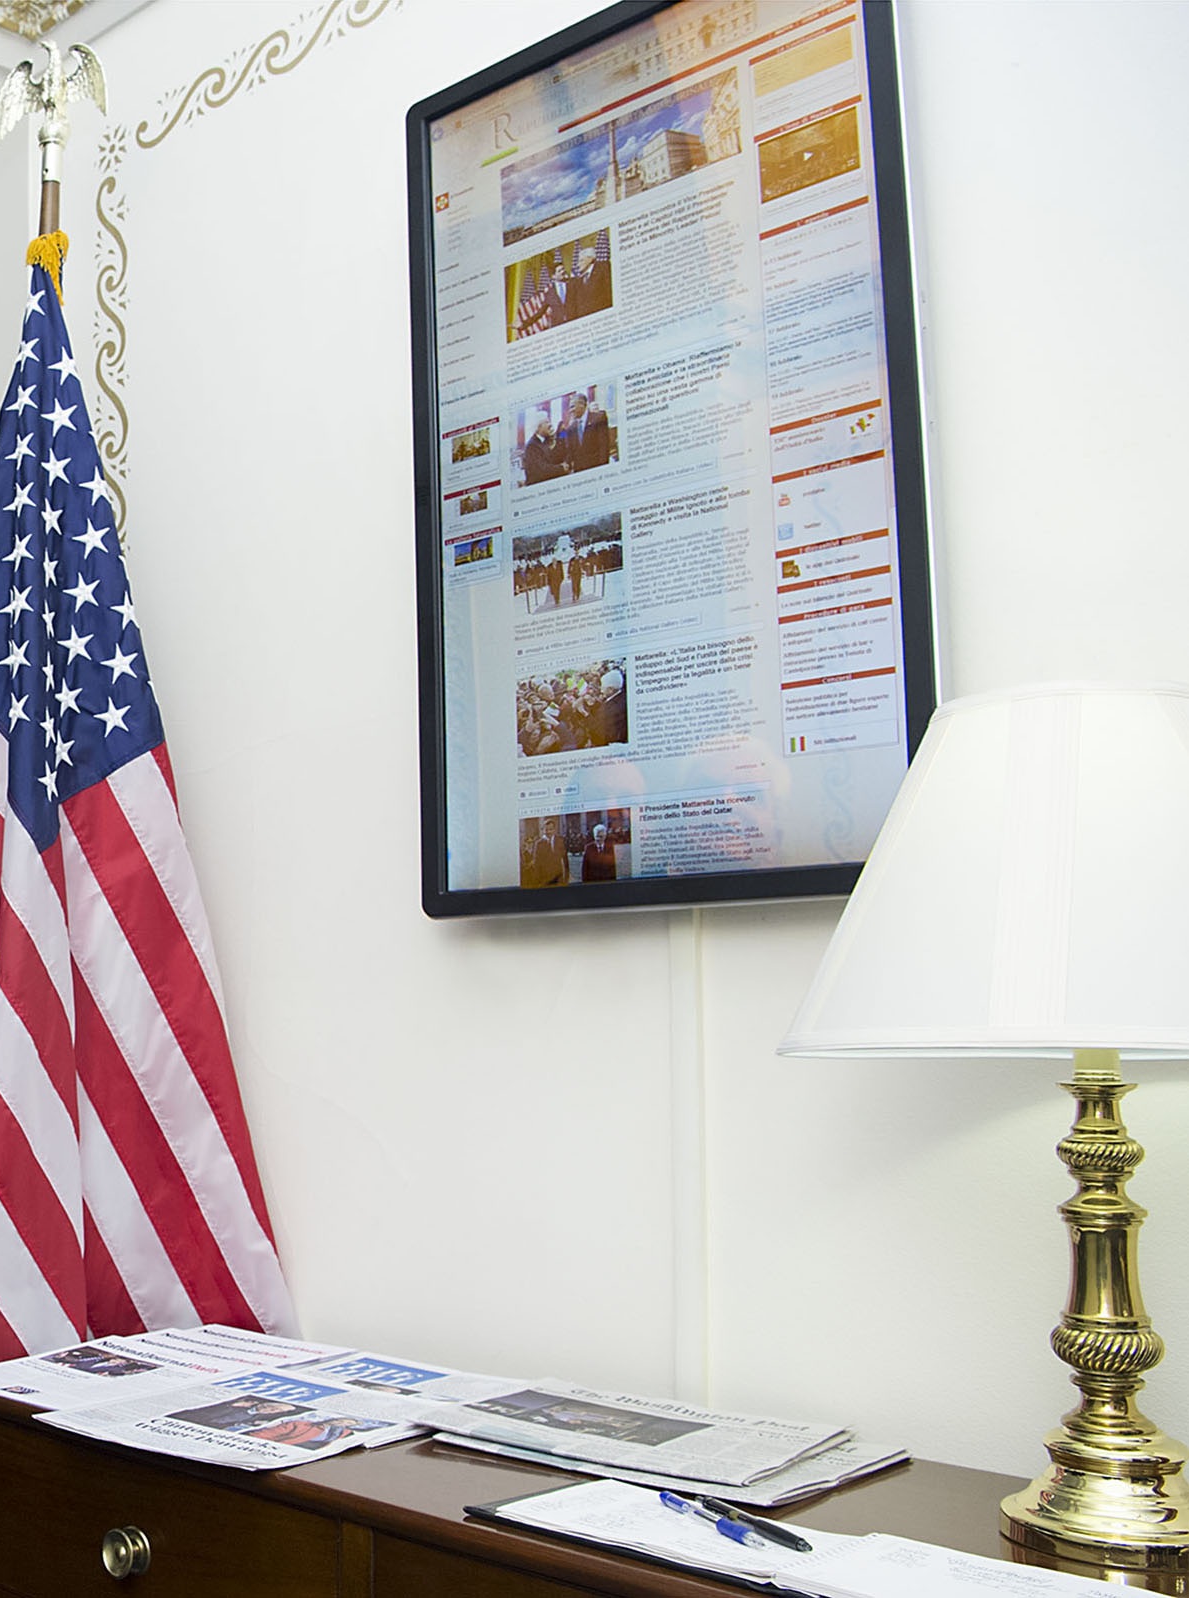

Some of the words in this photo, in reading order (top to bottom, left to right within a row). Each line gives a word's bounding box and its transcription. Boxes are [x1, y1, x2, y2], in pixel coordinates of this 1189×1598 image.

[624, 367, 655, 381] Mattarella
[625, 378, 671, 397] collaborazione
[629, 502, 661, 516] Mattarella
[668, 490, 707, 507] Washington
[708, 485, 728, 496] rende
[630, 511, 658, 524] omaggio
[666, 505, 684, 515] Milite
[686, 499, 707, 511] Ignoto
[715, 494, 726, 503] alla
[638, 517, 665, 530] Kennedy
[674, 511, 691, 521] visita
[700, 502, 728, 515] National
[631, 528, 652, 540] Gallery
[707, 638, 735, 650] bisogno
[635, 660, 662, 671] sviluppo
[677, 655, 689, 663] Sud
[719, 648, 729, 656] del
[635, 665, 682, 679] indispensabile
[696, 659, 717, 668] uscire
[719, 656, 735, 664] dalla
[734, 661, 751, 670] bene
[639, 813, 662, 822] l'Emiro
[664, 811, 680, 819] dello
[682, 809, 699, 817] Stato
[713, 806, 732, 814] Qatar
[644, 803, 679, 812] Presidente
[681, 799, 714, 809] Mattarella
[726, 795, 755, 804] ricevuto
[615, 1395, 747, 1423] Washington
[753, 1419, 811, 1432] Post
[150, 1418, 211, 1436] Clinton
[214, 1432, 281, 1451] attacks
